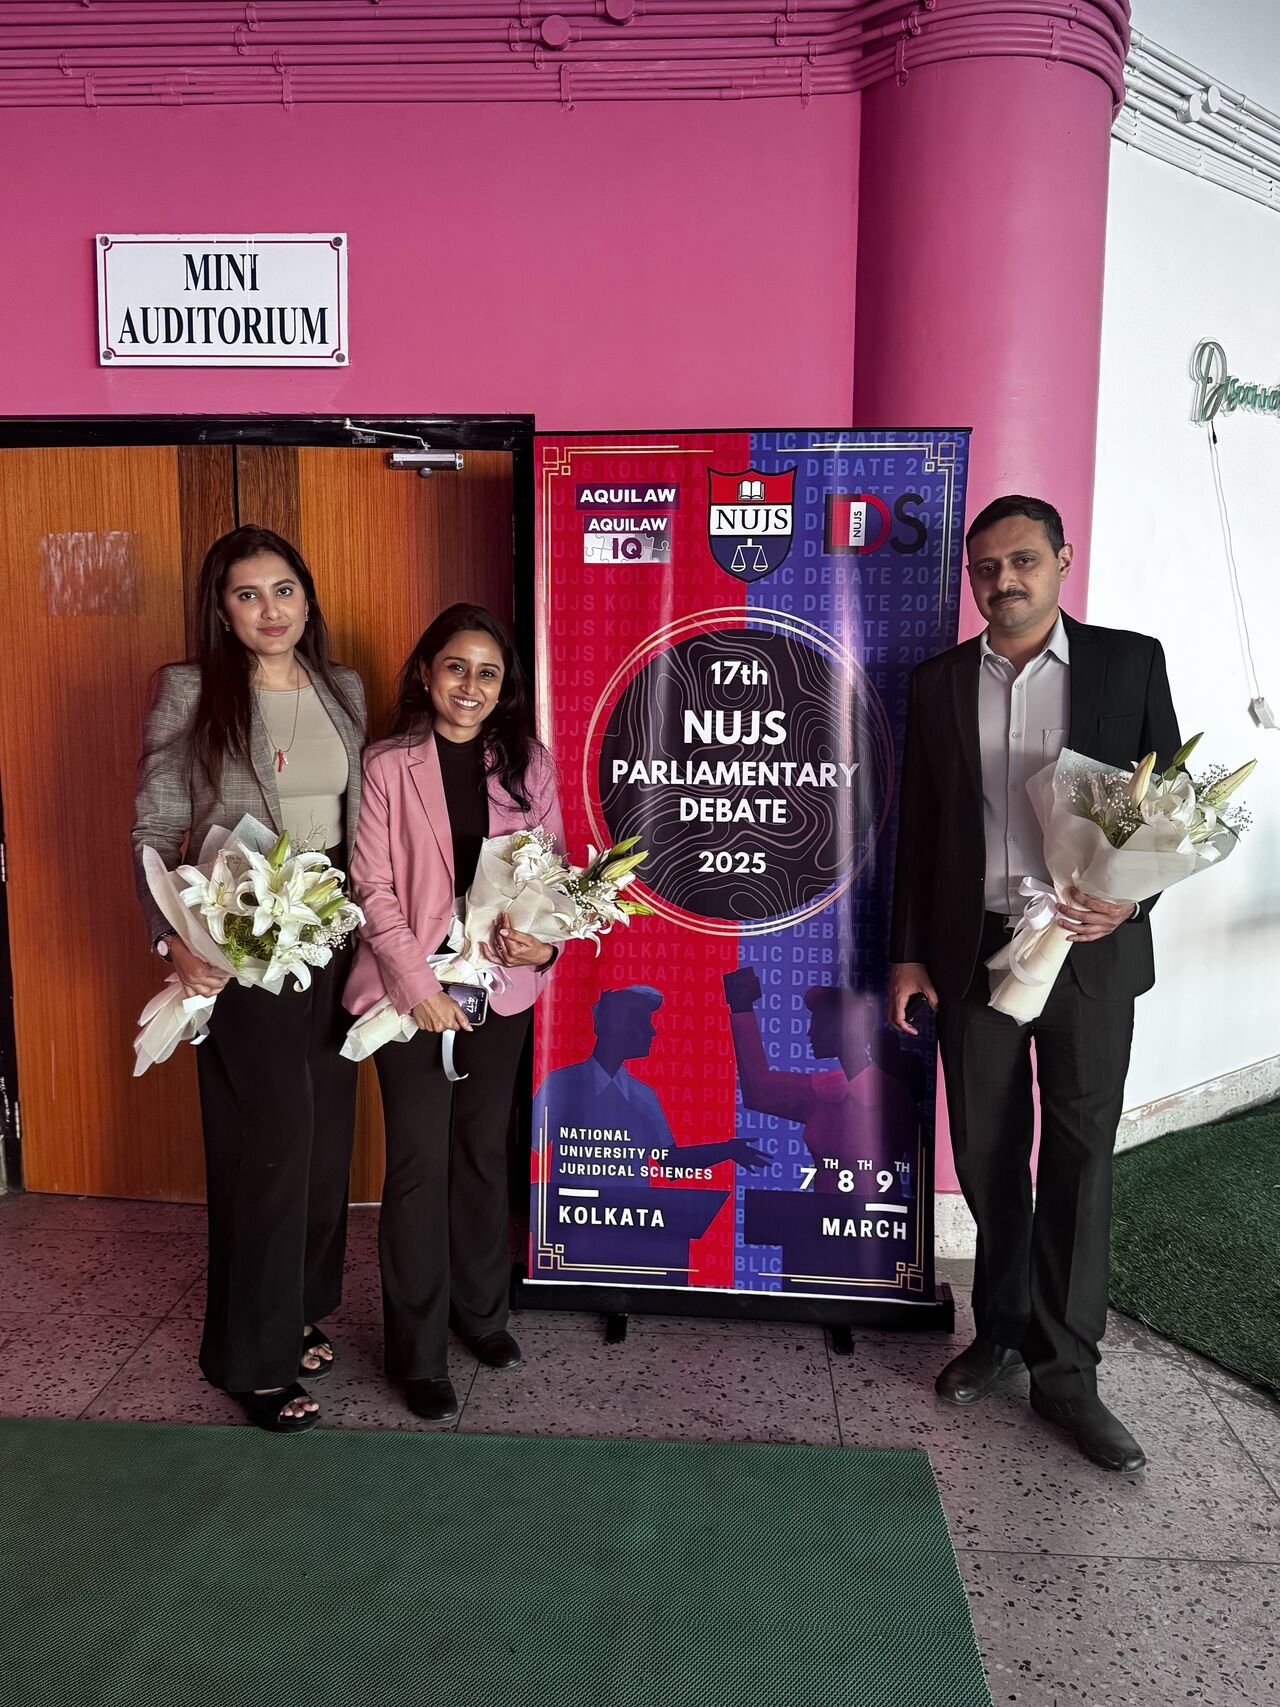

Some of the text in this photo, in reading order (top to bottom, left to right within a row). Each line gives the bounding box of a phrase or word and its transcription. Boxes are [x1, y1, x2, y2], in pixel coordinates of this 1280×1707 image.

[184, 253, 259, 291] MINI
[118, 306, 329, 345] AUDITORIUM
[806, 458, 895, 476] DEBATE
[580, 488, 676, 504] AQUILAW
[588, 517, 668, 532] AQUILAW
[716, 508, 789, 533] NUJS
[853, 510, 863, 538] NUJS
[612, 537, 643, 559] IQ
[804, 567, 892, 585] DEBATE
[803, 594, 891, 612] DEBATE
[710, 660, 768, 686] 17th
[683, 709, 787, 746] NUJS
[612, 759, 860, 788] PARLIAMENTARY
[680, 797, 787, 823] DEBATE
[698, 851, 767, 874] 2025
[704, 945, 783, 963] PUBLIC
[559, 1126, 631, 1142] NATIONAL
[559, 1144, 670, 1161] UNIVERSITY OF
[559, 1161, 713, 1180] JURIDICAL SCIENCES
[558, 1205, 665, 1228] KOLKATA
[822, 1217, 907, 1241] MARCH
[706, 1255, 782, 1273] PUBLIC
